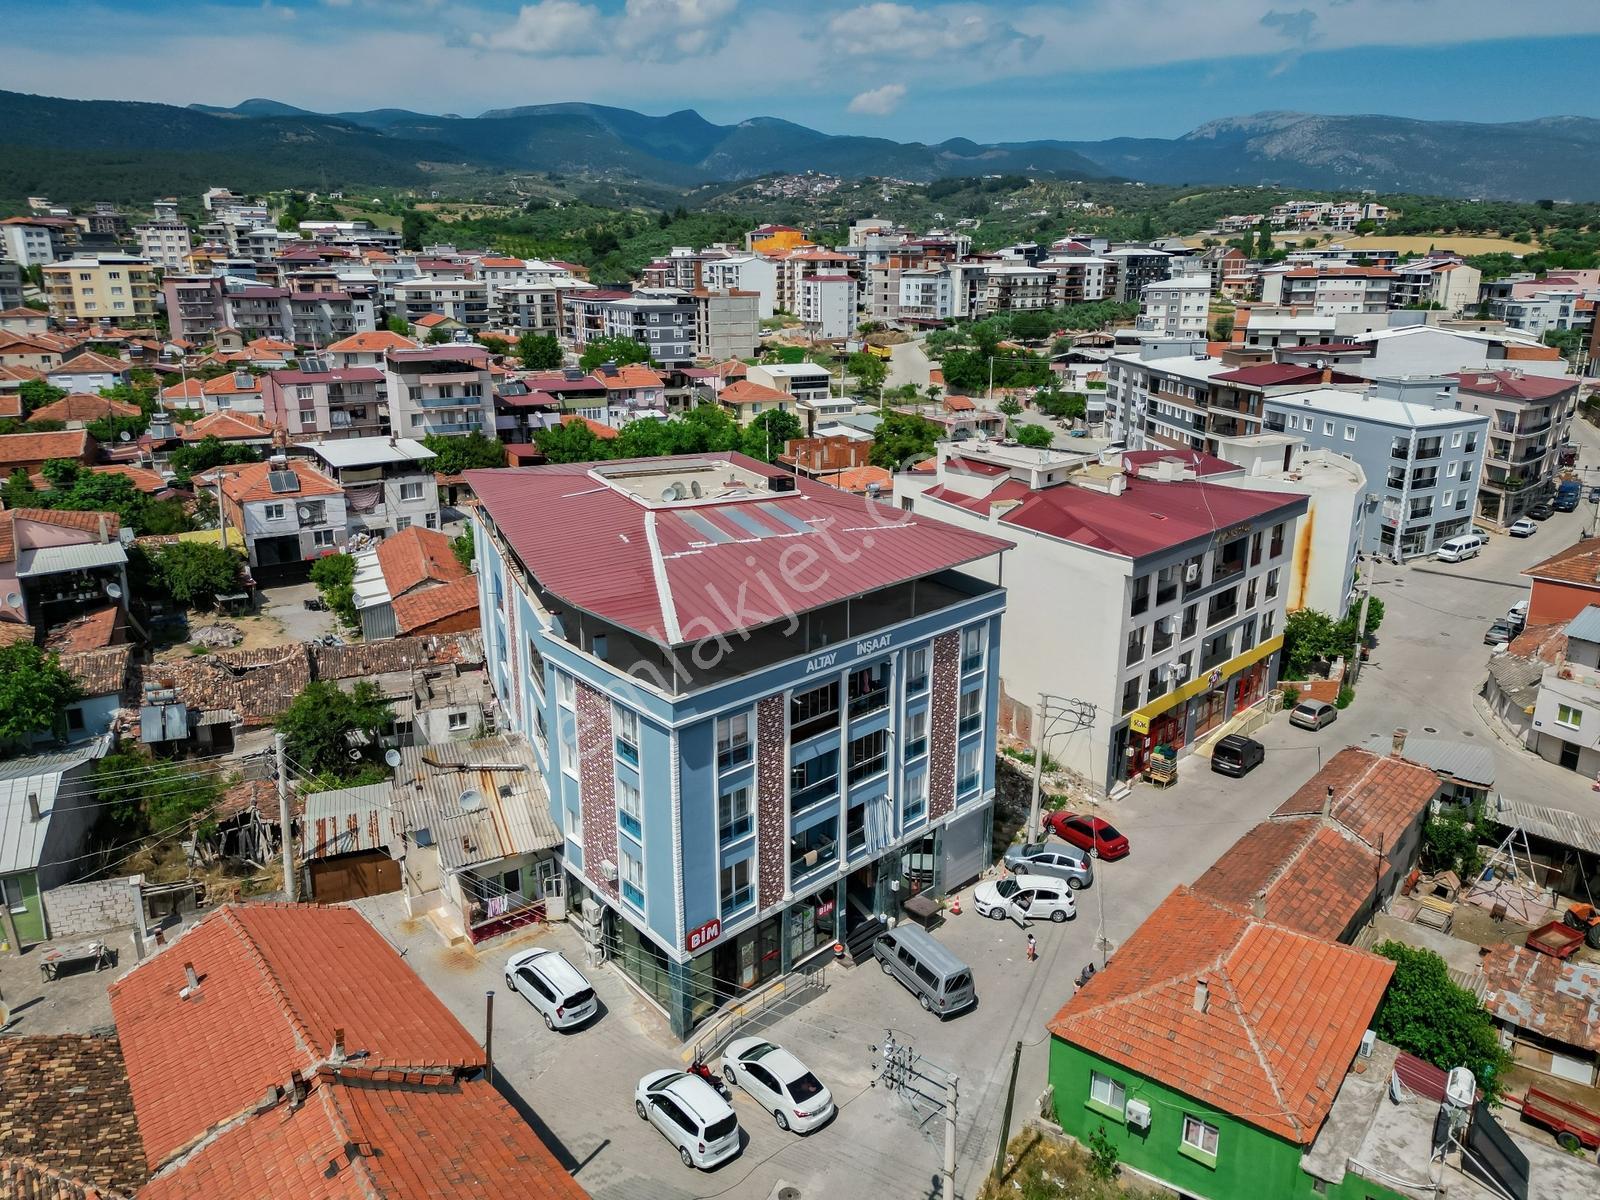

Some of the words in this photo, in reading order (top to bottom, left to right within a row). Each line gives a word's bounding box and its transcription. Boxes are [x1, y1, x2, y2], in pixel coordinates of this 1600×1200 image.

[806, 652, 837, 673] ALTAY
[857, 634, 892, 655] İNŞAAT
[691, 923, 718, 948] BİM
